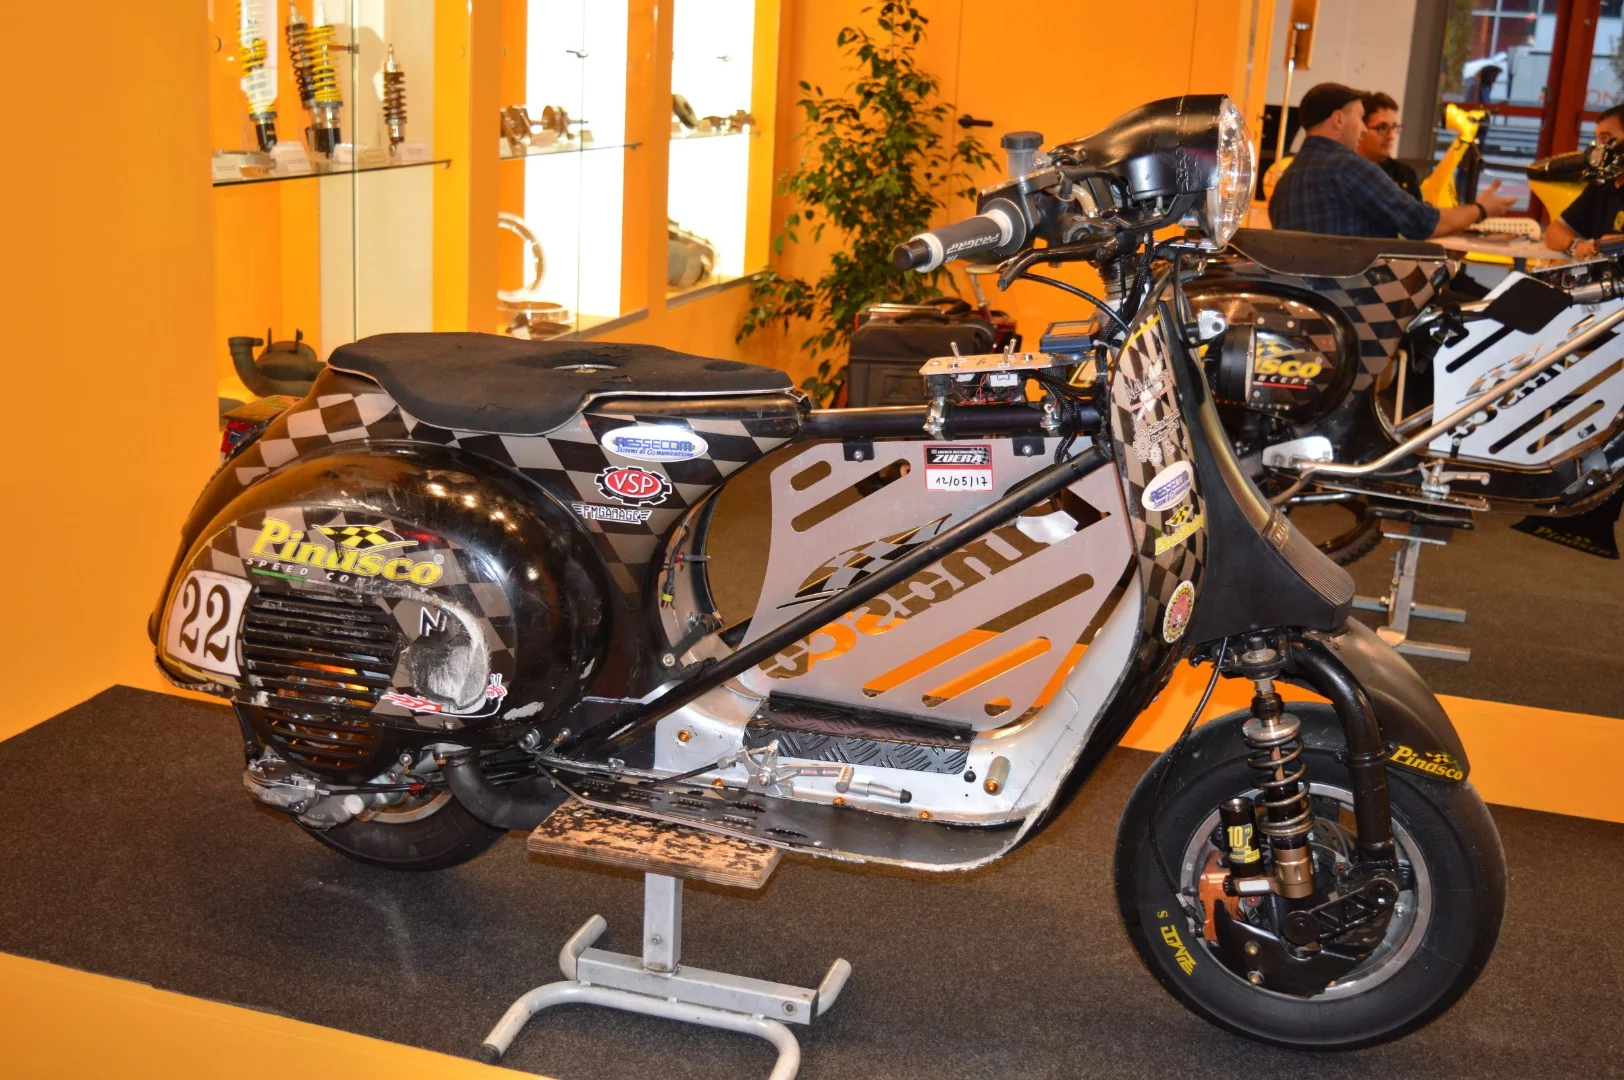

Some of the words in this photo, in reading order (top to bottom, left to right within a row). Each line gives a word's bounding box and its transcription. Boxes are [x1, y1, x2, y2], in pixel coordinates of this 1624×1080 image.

[613, 473, 654, 494] VSP
[936, 476, 988, 488] 12/05/17
[250, 517, 444, 586] Pinasco
[246, 557, 308, 577] SPEED
[178, 575, 232, 663] 22
[1389, 745, 1464, 780] Pinasco
